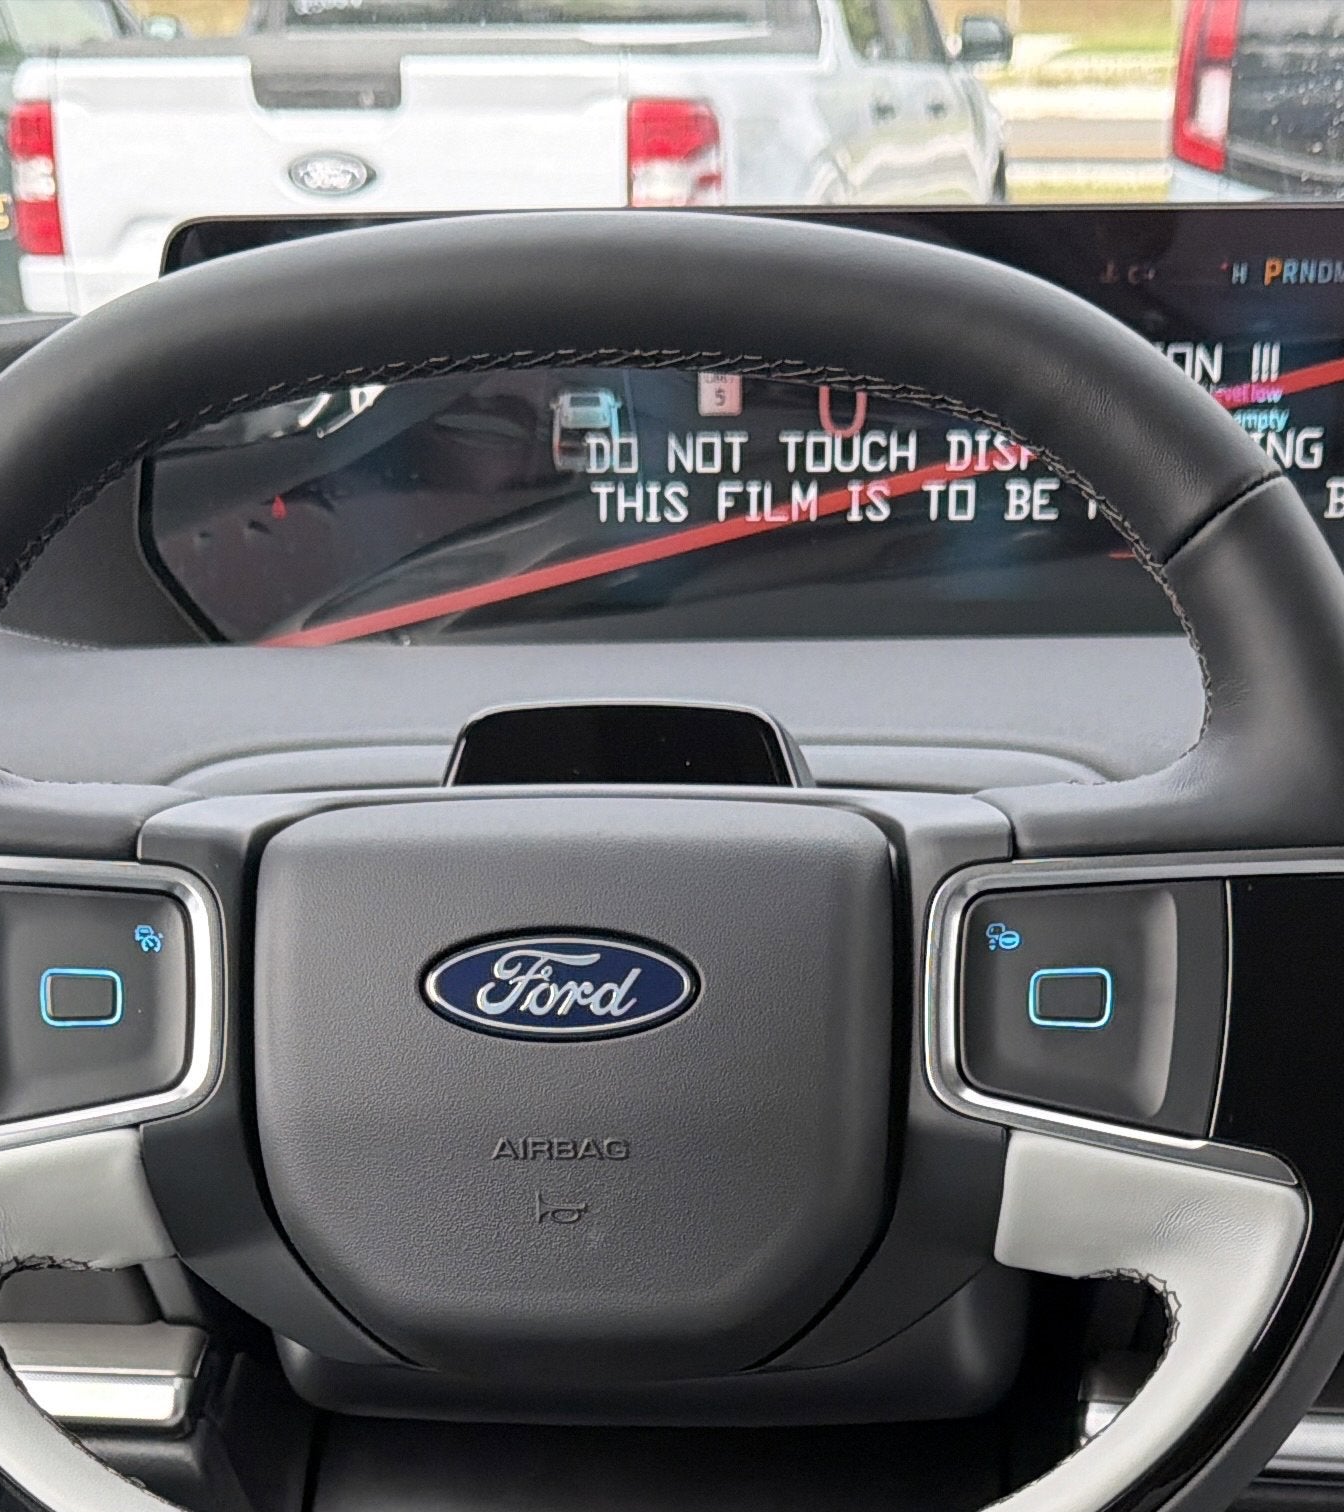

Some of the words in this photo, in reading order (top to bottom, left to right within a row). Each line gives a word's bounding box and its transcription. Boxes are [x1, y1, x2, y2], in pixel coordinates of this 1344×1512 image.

[585, 431, 639, 474] DO
[667, 430, 749, 474] NOT
[778, 430, 918, 474] TOUCH
[590, 480, 689, 523] THIS
[717, 479, 819, 523] FILM
[846, 478, 892, 522] IS
[921, 478, 977, 521] TO
[1004, 477, 1061, 521] BE
[476, 949, 643, 1017] Ford
[491, 1136, 631, 1161] AIRBAG
